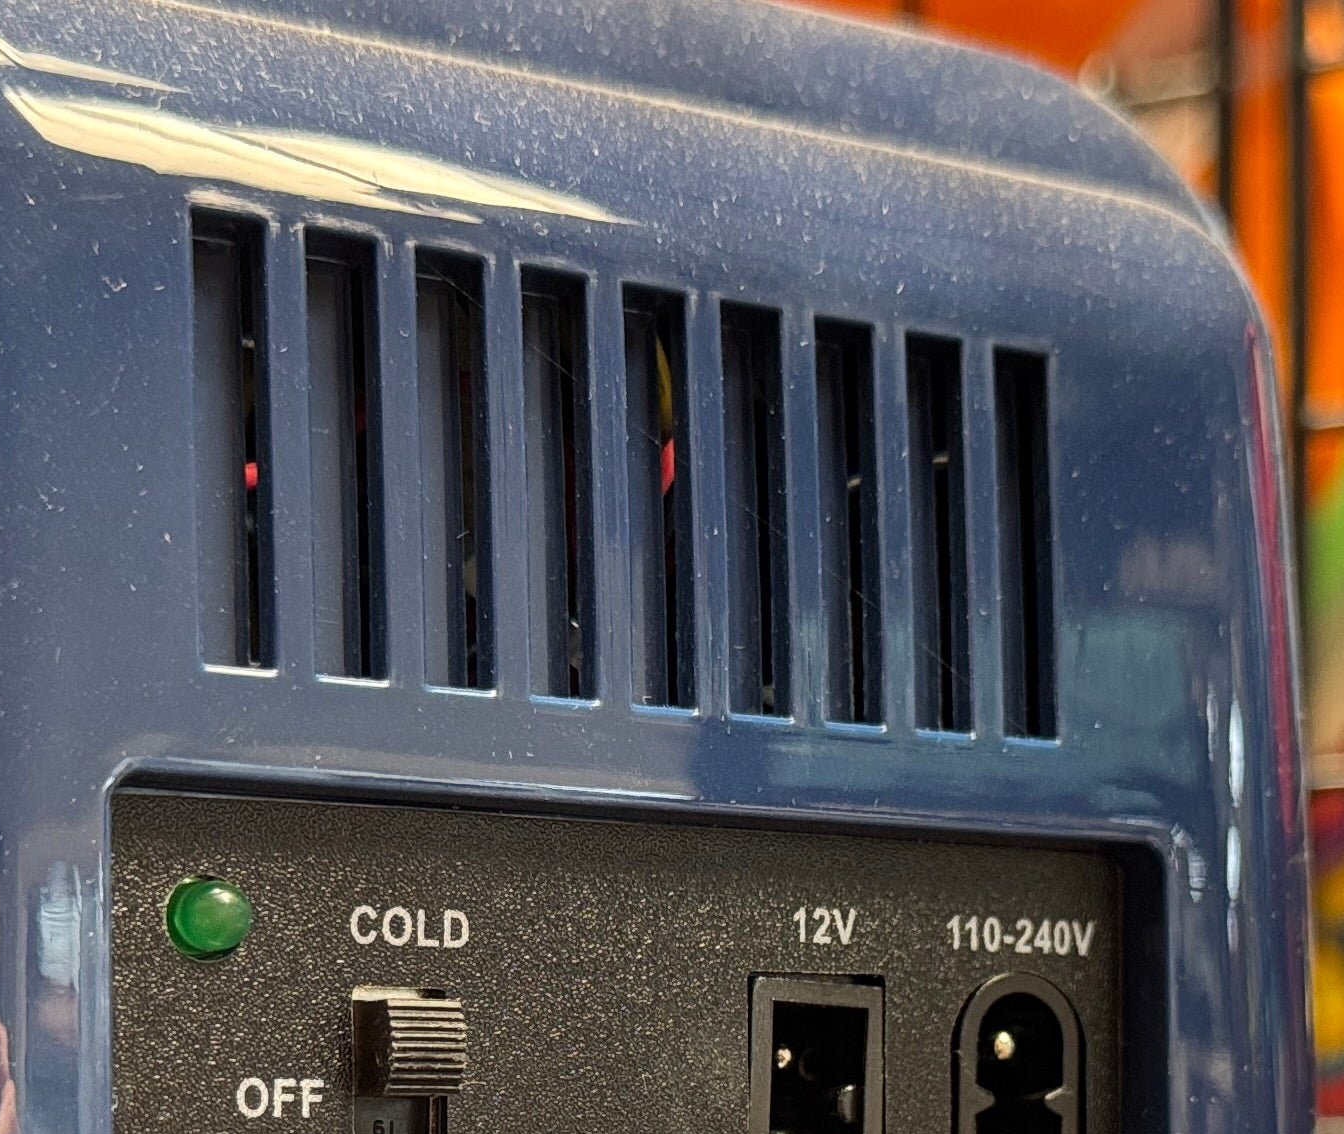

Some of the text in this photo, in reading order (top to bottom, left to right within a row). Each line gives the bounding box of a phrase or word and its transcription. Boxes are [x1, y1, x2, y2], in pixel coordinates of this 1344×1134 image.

[349, 905, 469, 948] COLD
[793, 906, 856, 945] 12V
[946, 915, 1095, 957] 110-240V
[236, 1077, 324, 1118] OFF
